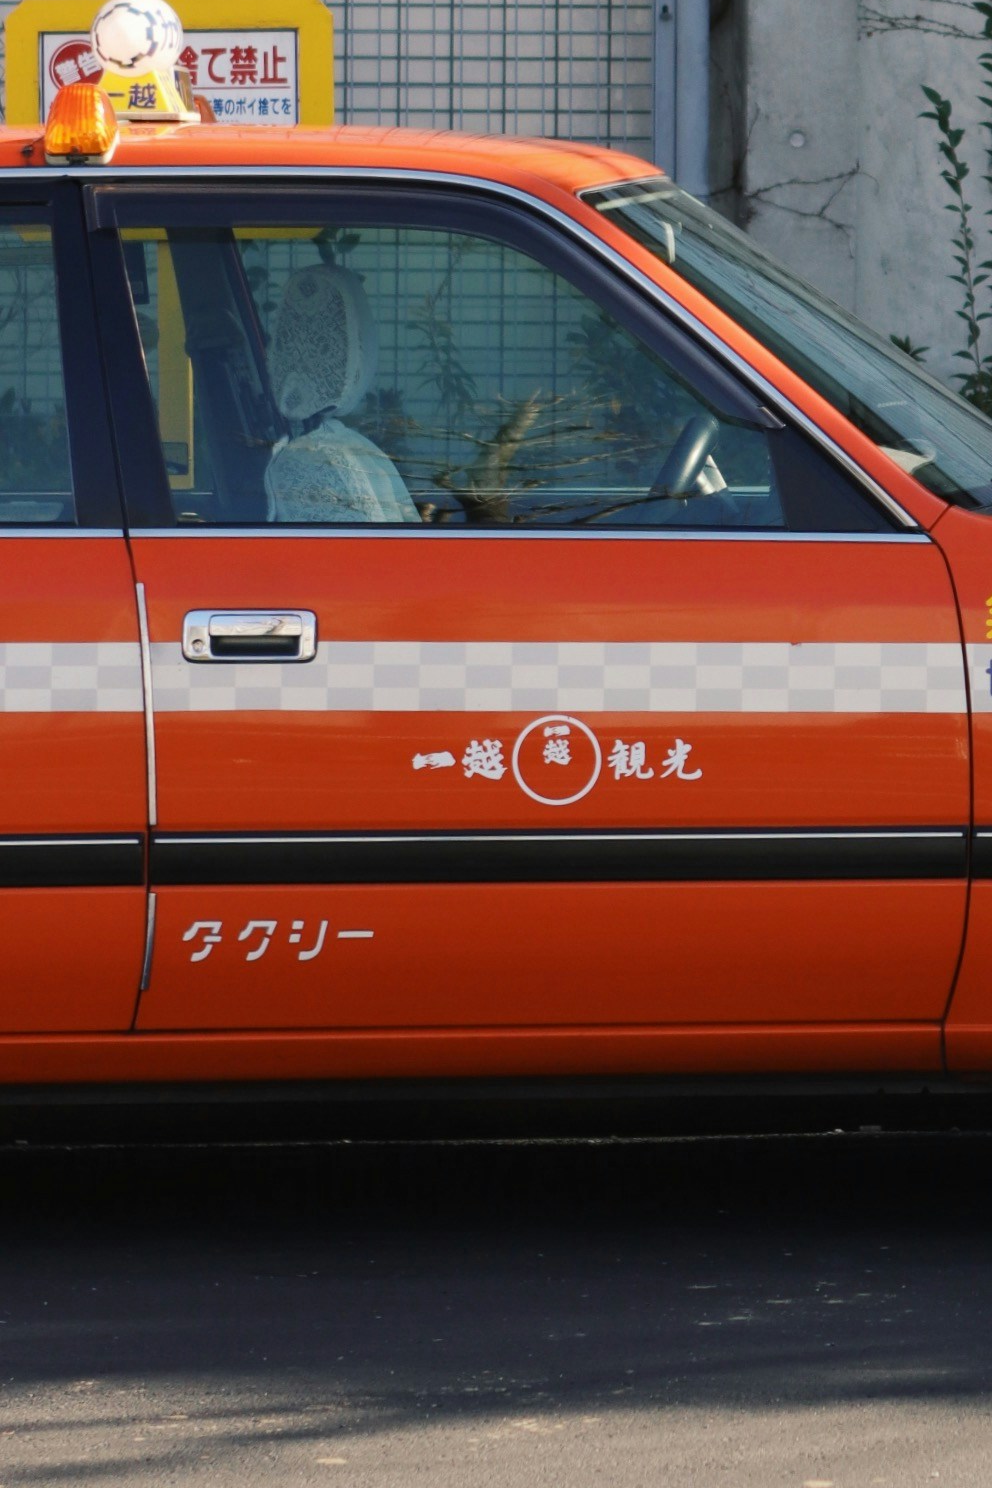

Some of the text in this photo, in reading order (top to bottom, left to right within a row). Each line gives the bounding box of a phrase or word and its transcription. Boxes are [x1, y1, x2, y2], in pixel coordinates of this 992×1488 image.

[107, 83, 156, 110] 一越
[208, 97, 292, 116] 等のポイ捨てを
[411, 739, 702, 780] 一越 観光
[182, 920, 375, 962] タクシー
